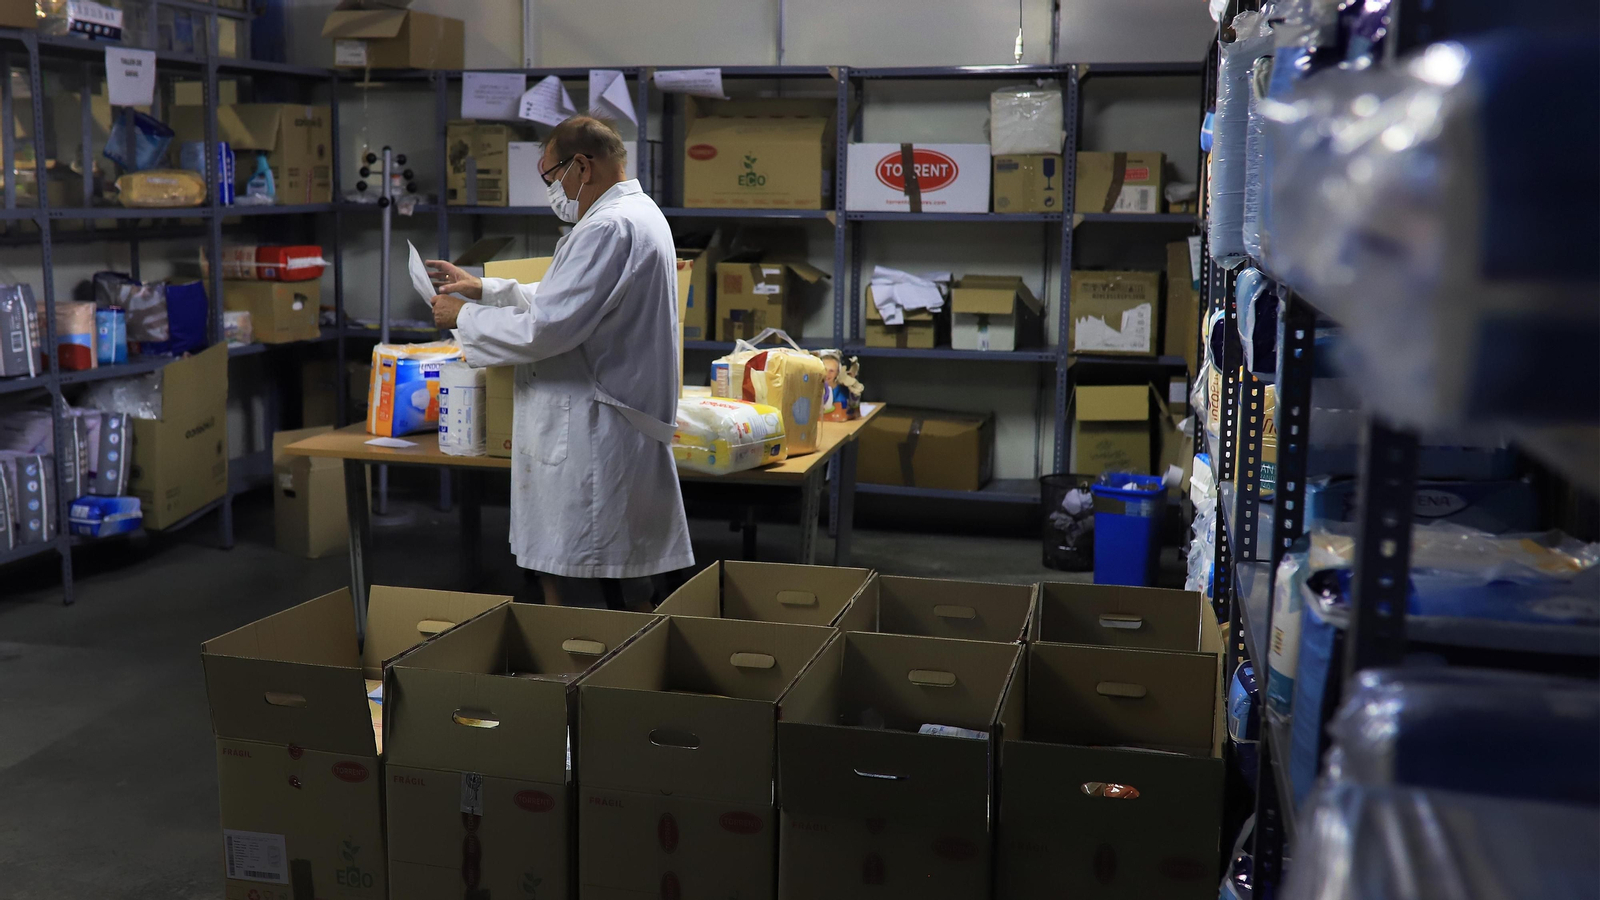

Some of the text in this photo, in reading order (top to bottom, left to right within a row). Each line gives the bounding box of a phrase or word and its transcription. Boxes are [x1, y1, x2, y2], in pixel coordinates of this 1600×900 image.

[884, 163, 949, 177] TORENT
[738, 172, 766, 187] ECO
[420, 362, 445, 371] LINDO
[1416, 495, 1451, 507] ENA
[335, 767, 366, 778] TORRENT
[393, 775, 426, 787] FRÁGIL
[518, 795, 550, 806] TORRENT
[336, 866, 374, 889] ECO
